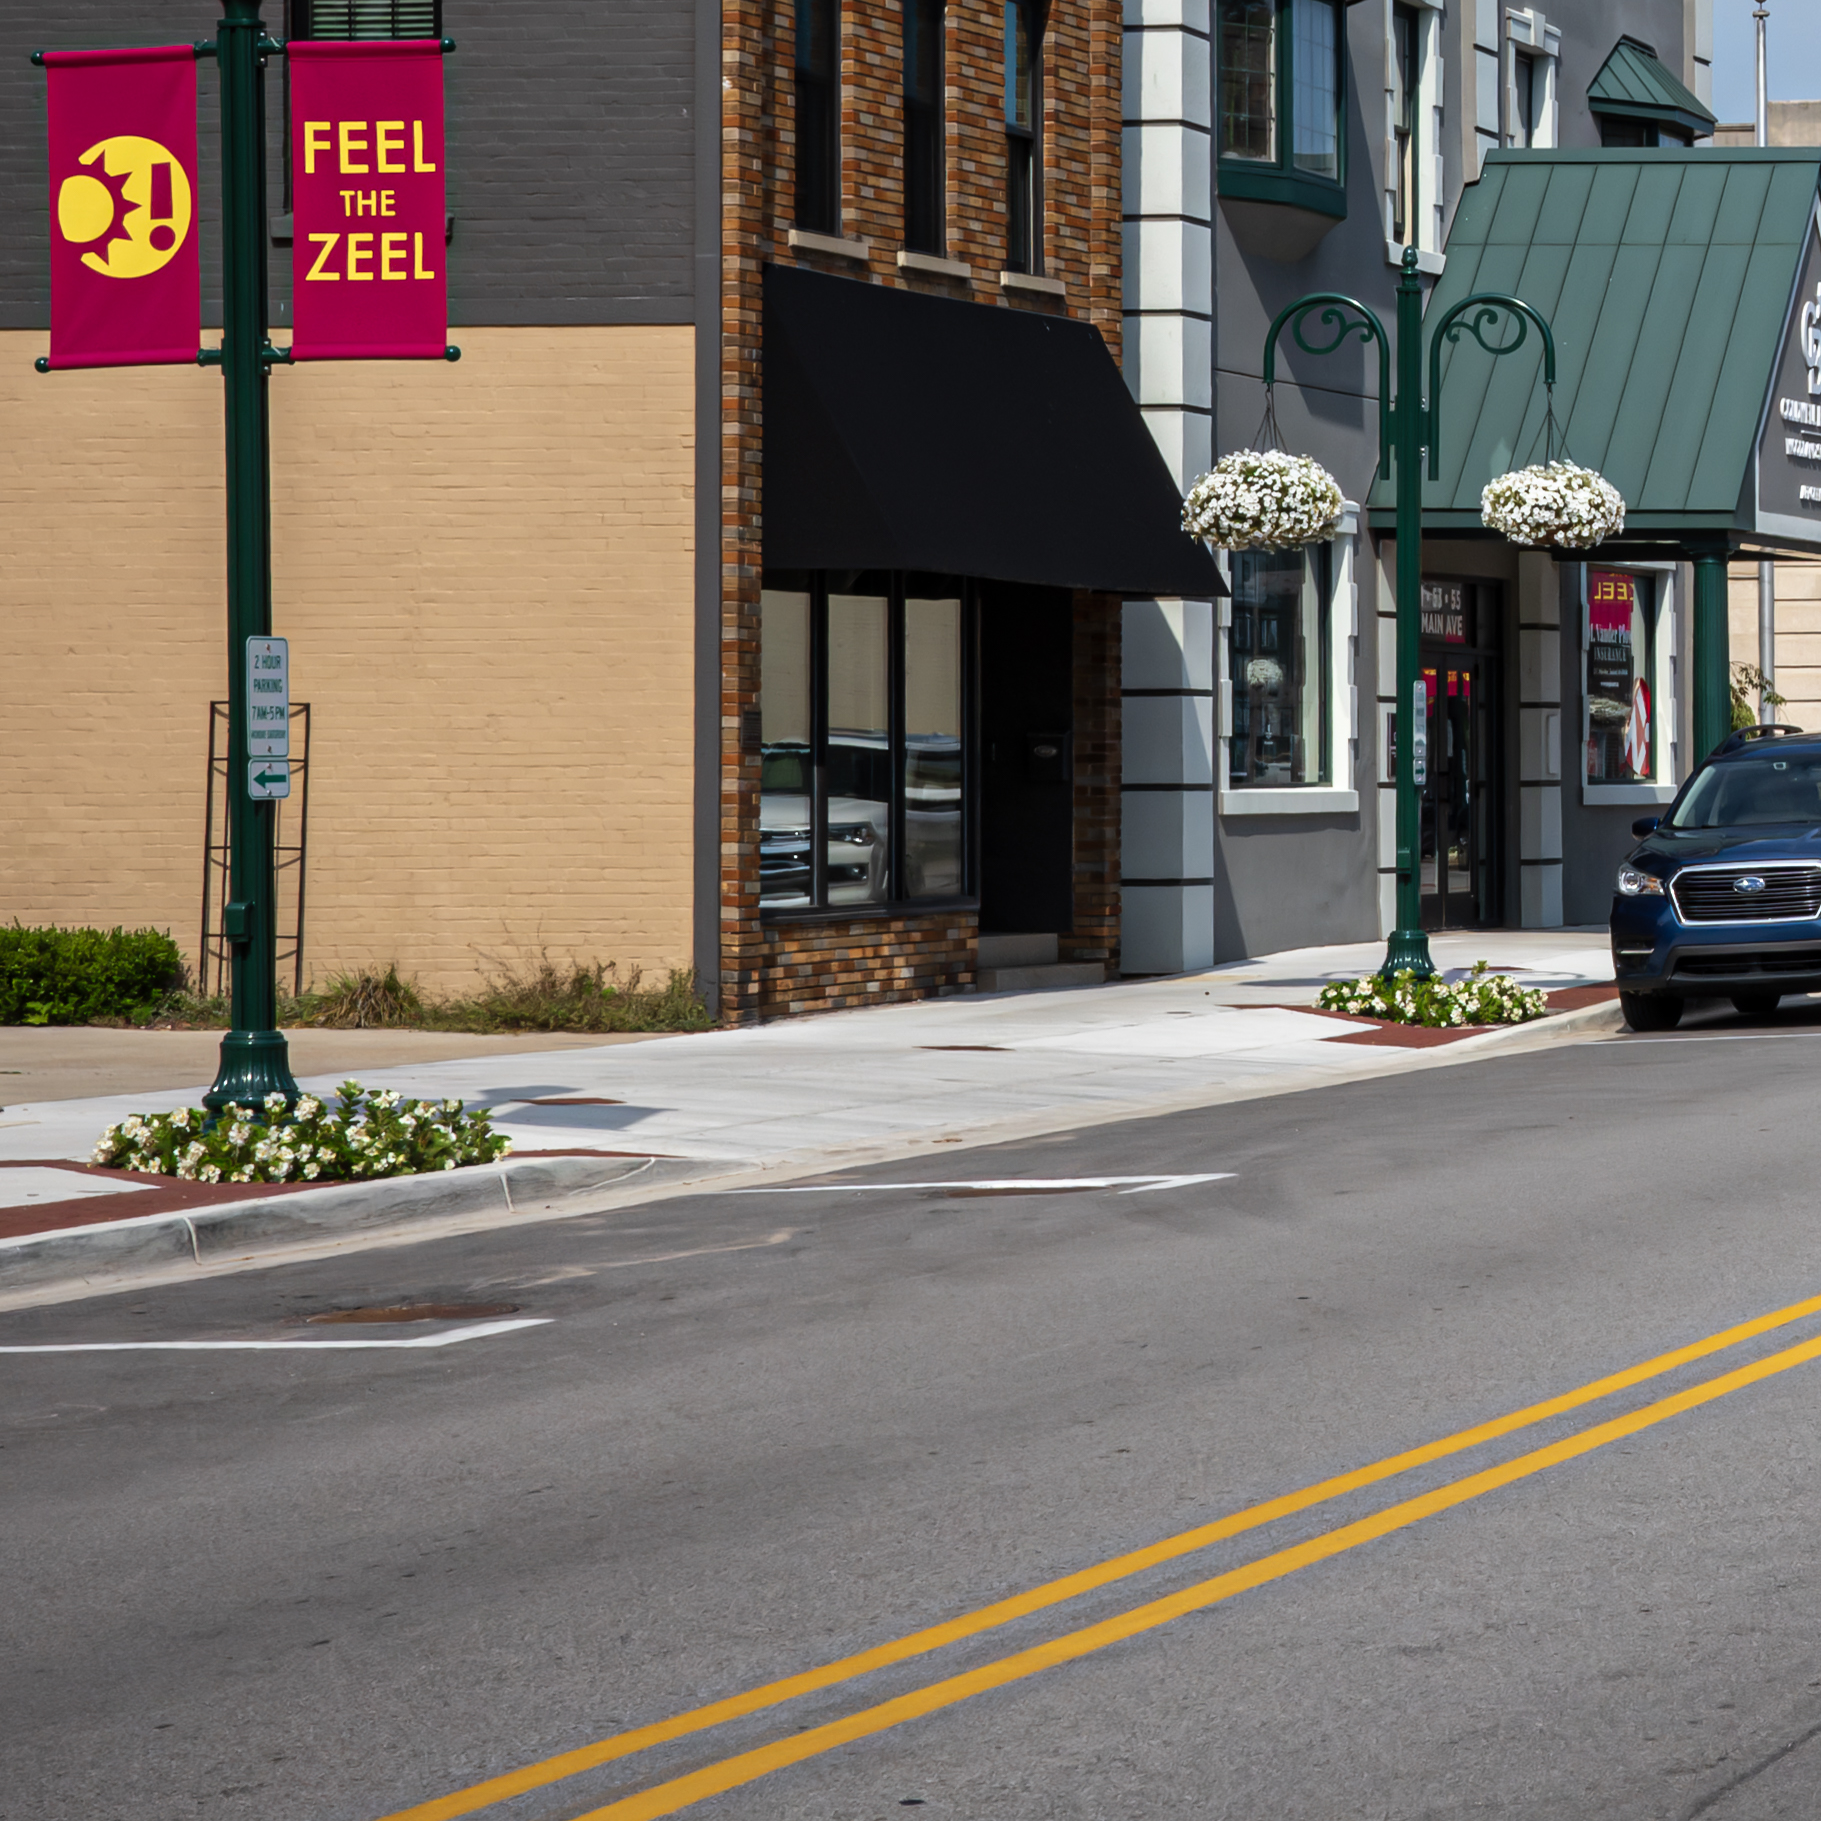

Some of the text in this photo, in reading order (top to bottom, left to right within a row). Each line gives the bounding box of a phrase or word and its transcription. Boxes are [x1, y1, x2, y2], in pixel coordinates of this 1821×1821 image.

[304, 120, 436, 174] FEEL
[339, 190, 396, 217] THE
[305, 232, 435, 281] ZEEL
[1450, 589, 1461, 611] 55
[1421, 612, 1463, 636] MAIN AVE
[254, 655, 282, 669] 2 HOUR
[253, 678, 283, 693] PARKING
